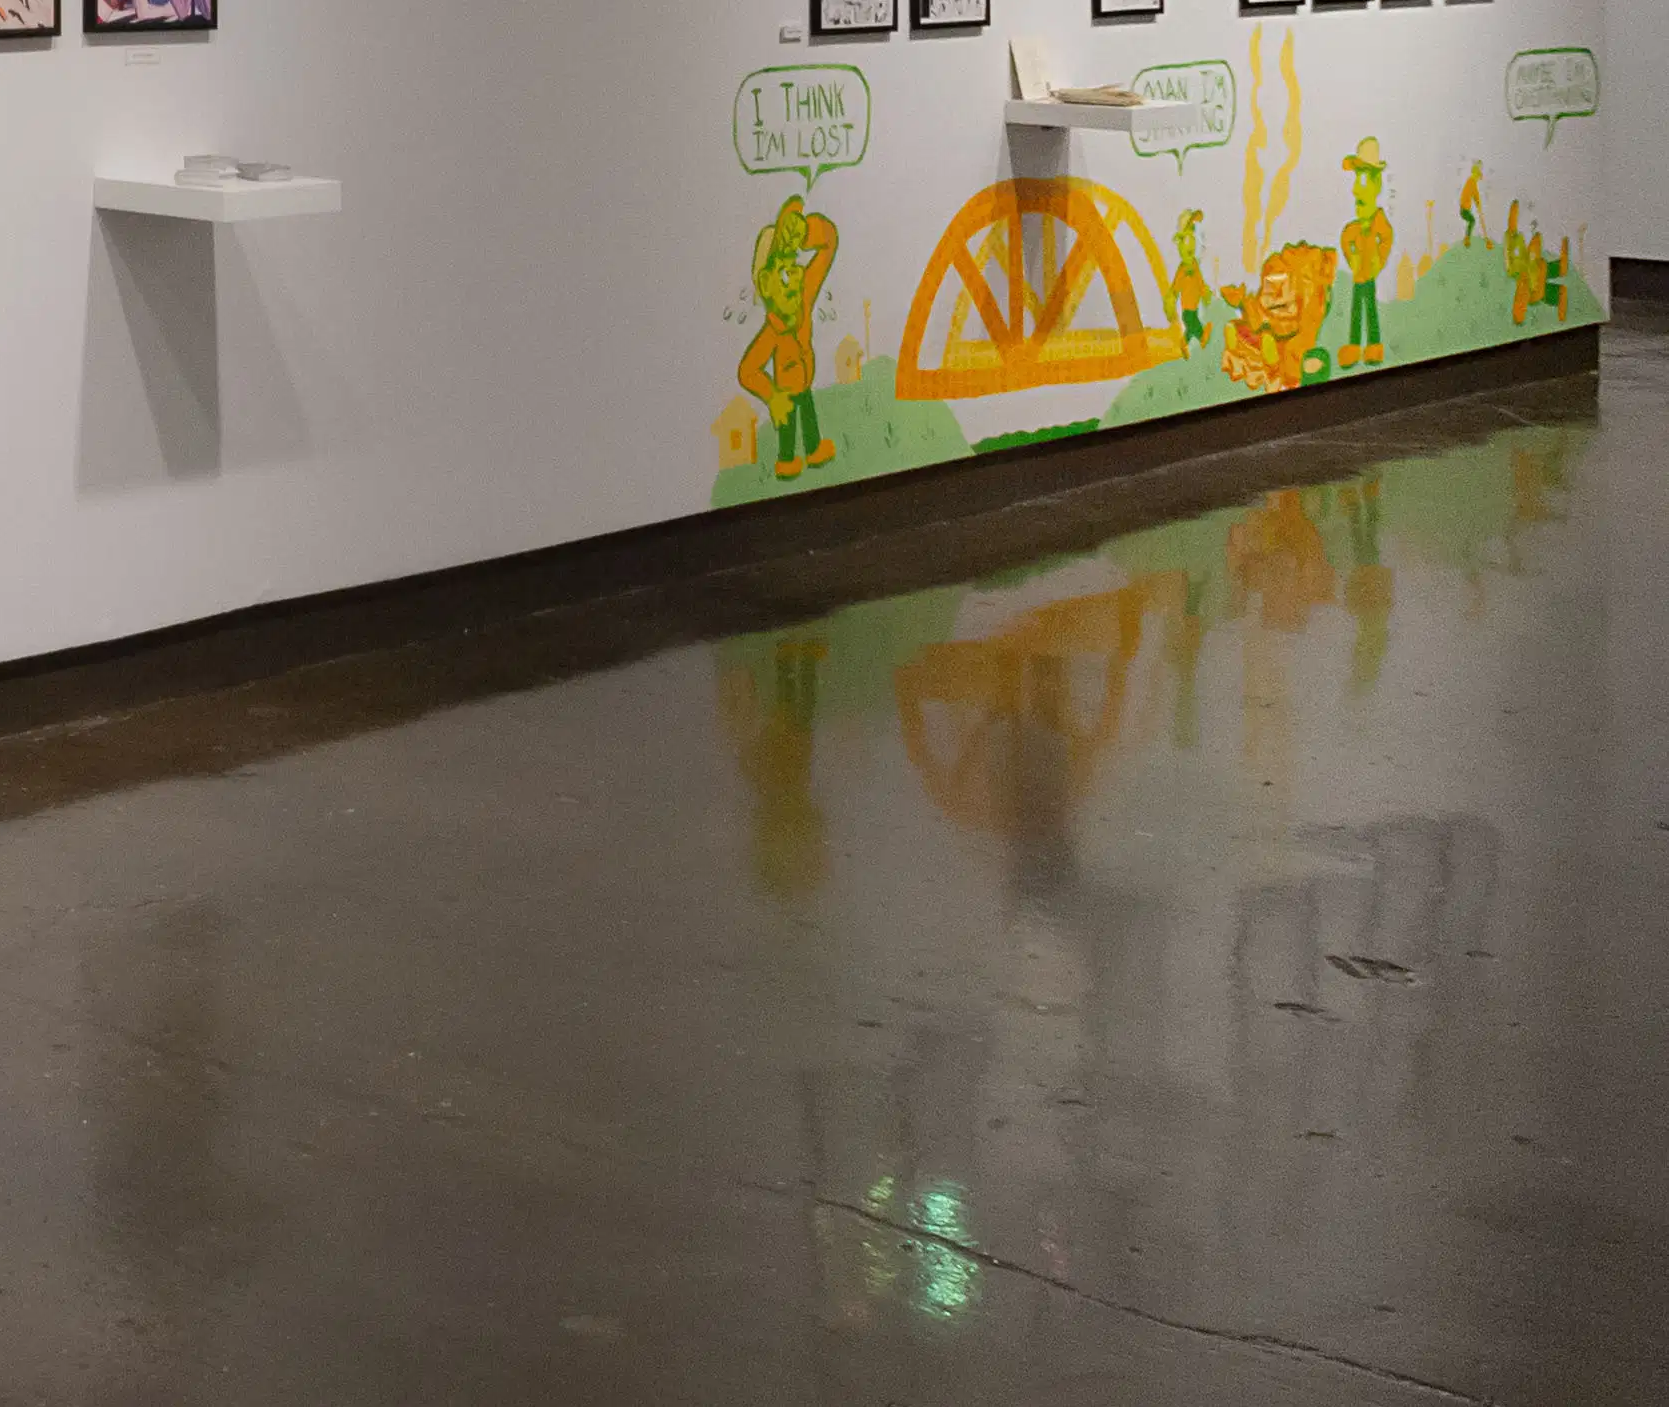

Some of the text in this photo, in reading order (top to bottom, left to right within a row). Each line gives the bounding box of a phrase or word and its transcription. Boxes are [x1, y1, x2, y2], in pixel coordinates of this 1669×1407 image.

[751, 80, 845, 127] I THINK
[797, 123, 855, 158] LOST
